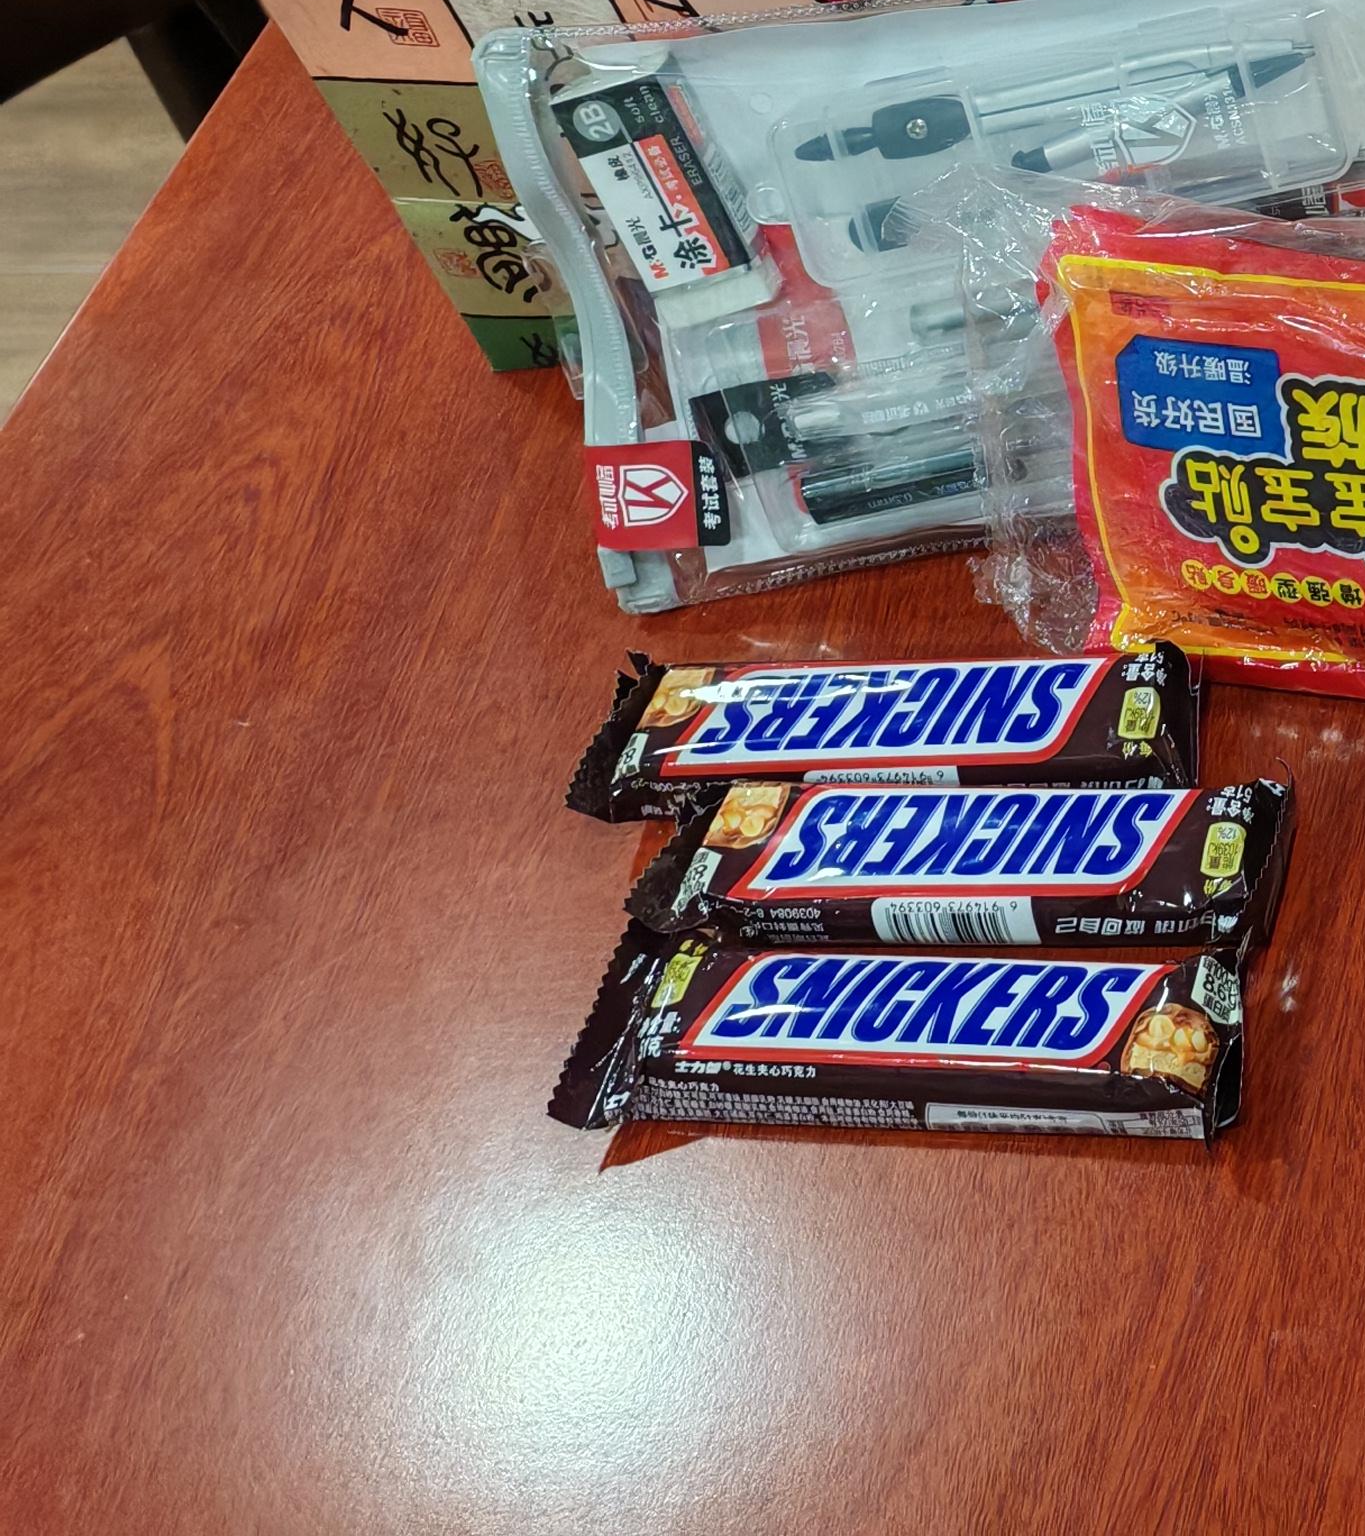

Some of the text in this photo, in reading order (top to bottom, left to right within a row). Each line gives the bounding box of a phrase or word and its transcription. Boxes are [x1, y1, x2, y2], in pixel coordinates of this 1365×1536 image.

[580, 103, 612, 140] 2B
[670, 135, 703, 185] ERASER
[1155, 350, 1251, 385] 温暖升级
[1132, 390, 1261, 439] 国民好货
[701, 456, 721, 529] 考试套装
[699, 663, 1091, 755] SNICKERS
[766, 793, 1174, 880] SNICKERS
[889, 899, 938, 913] 603394
[1055, 917, 1145, 935] 做回自己
[712, 958, 1149, 1050] SNICKERS
